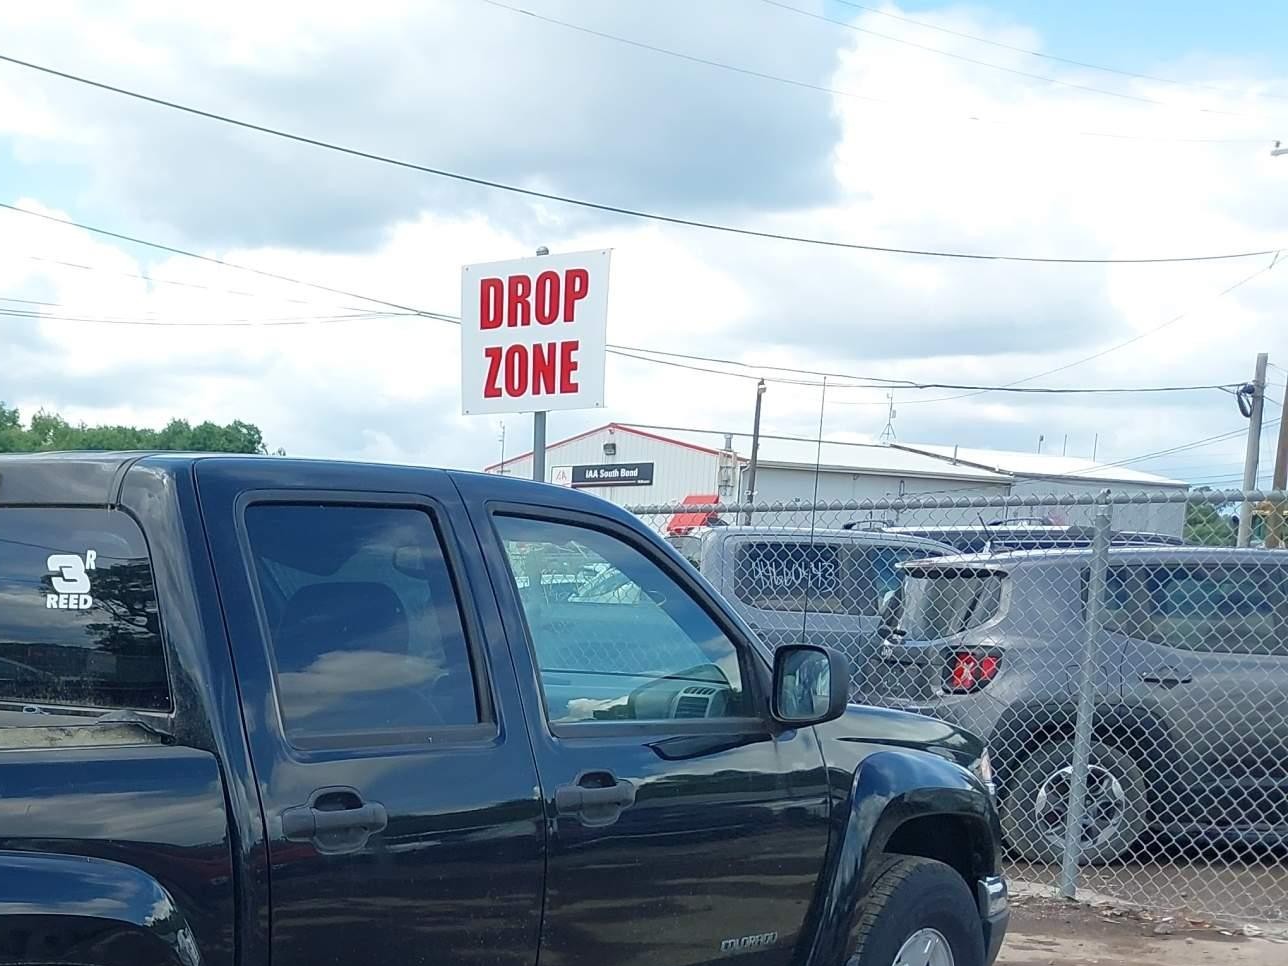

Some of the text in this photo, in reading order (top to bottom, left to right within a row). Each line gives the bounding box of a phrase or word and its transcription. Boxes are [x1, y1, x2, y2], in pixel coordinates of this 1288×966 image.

[480, 268, 589, 330] DROP
[484, 340, 579, 398] ZONE
[585, 469, 598, 479] IAA
[599, 468, 619, 479] South
[46, 593, 93, 610] REED
